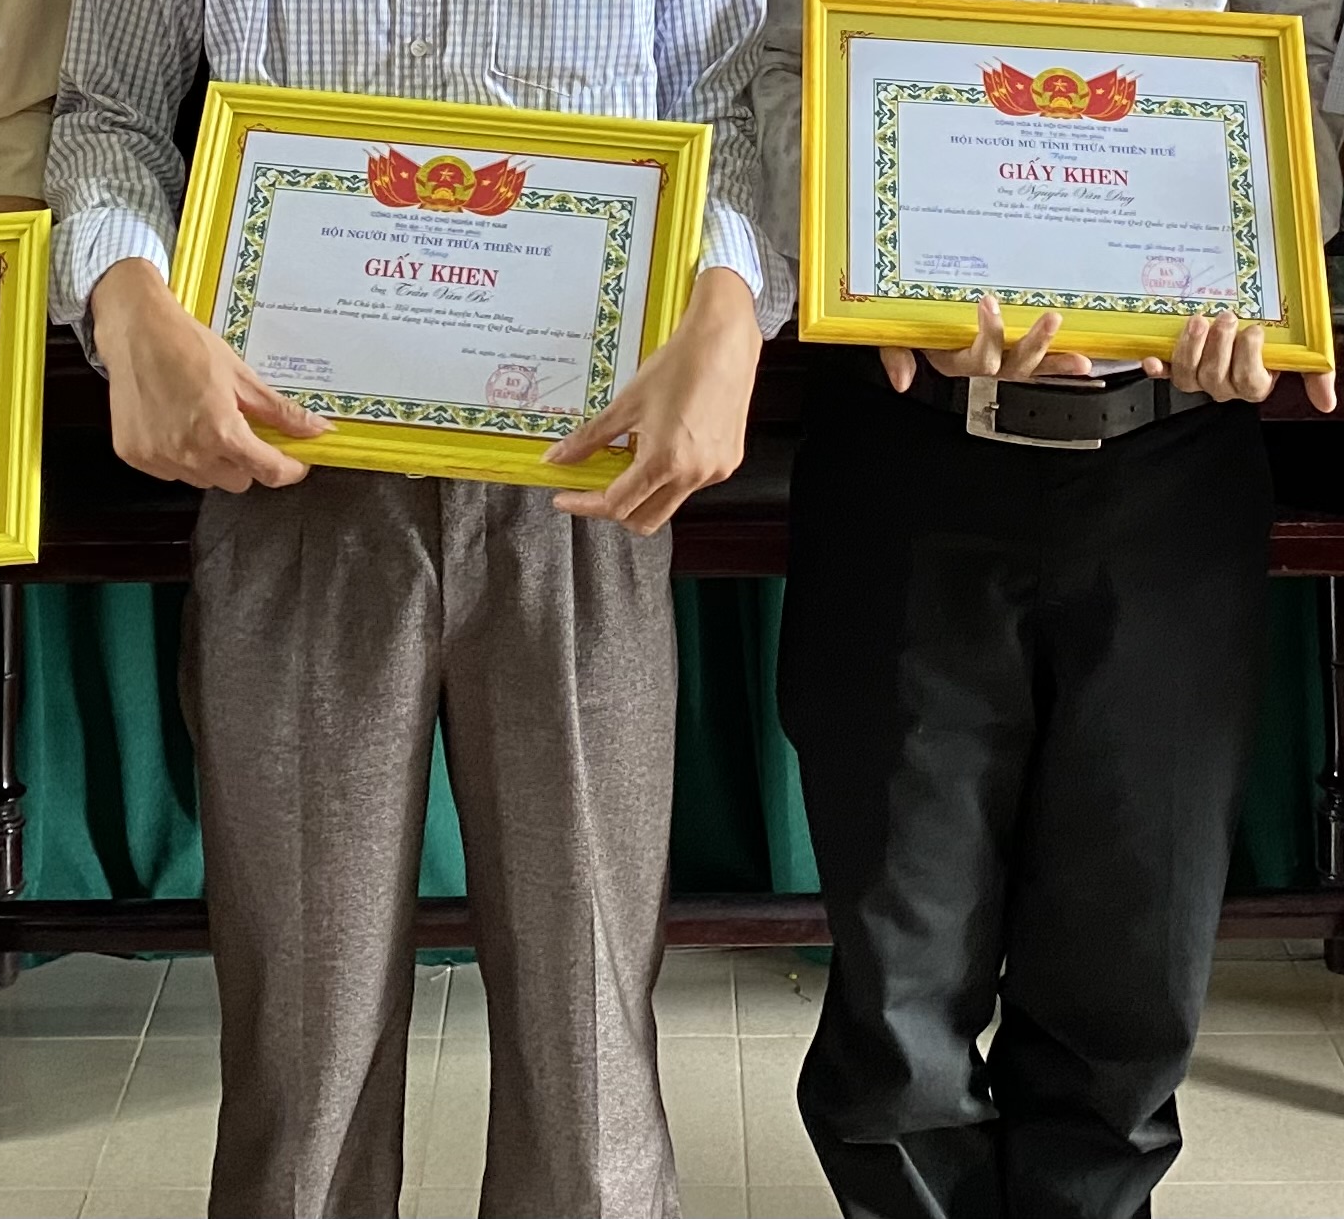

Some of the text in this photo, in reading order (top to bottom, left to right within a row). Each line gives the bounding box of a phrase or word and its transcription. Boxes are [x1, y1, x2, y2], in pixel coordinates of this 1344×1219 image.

[951, 135, 972, 145] HỘI
[976, 137, 1014, 147] NGƯỜI
[1018, 140, 1035, 148] MÙ
[1109, 145, 1146, 154] THIÊN
[999, 157, 1127, 185] GIẤY KHEN
[321, 226, 344, 238] HỘI
[347, 230, 386, 241] NGƯỜI
[390, 234, 409, 243] MÙ
[483, 242, 522, 253] THIÊN
[365, 253, 498, 286] GIẤY KHEN
